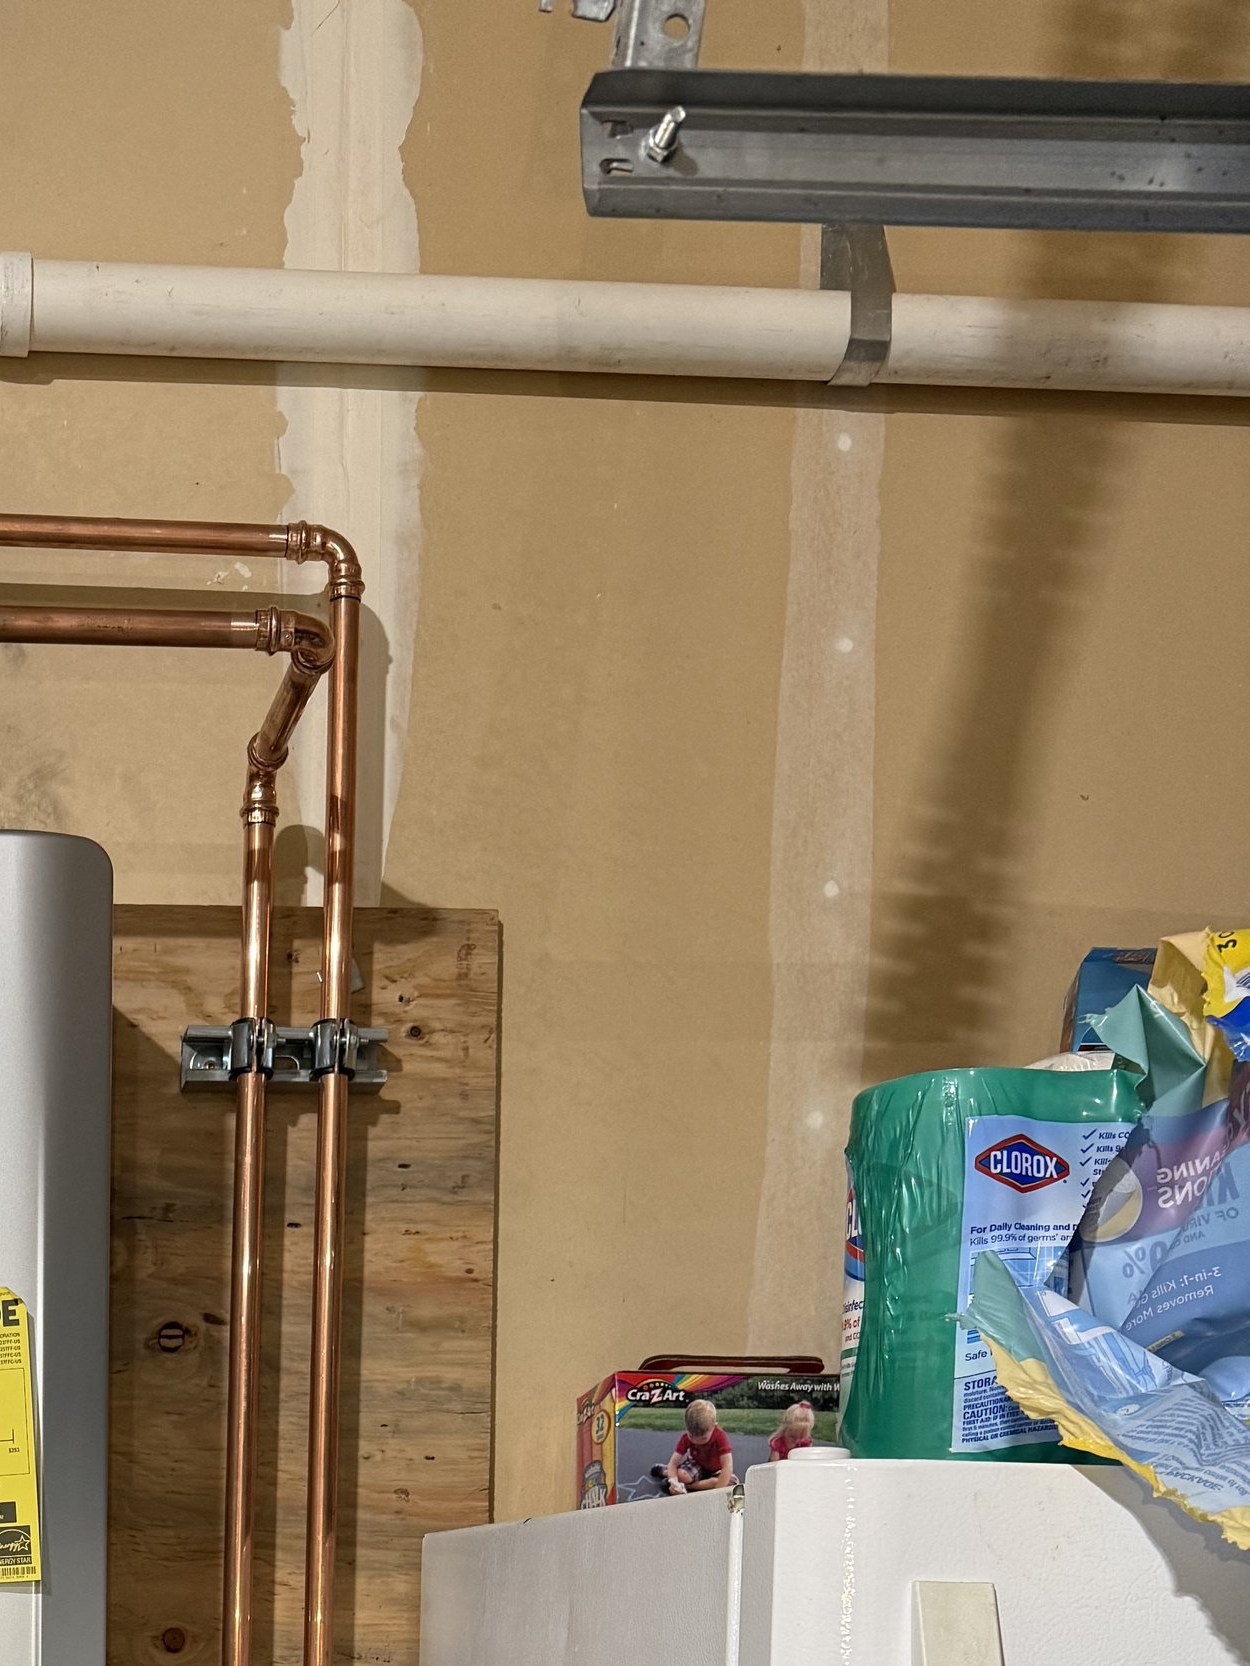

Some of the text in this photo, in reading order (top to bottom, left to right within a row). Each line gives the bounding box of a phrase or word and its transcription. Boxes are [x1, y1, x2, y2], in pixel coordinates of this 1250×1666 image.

[990, 1151, 1058, 1178] CLOROX
[971, 1226, 987, 1234] For
[990, 1223, 1012, 1232] Daily
[1014, 1223, 1050, 1231] Cleaning
[970, 1237, 988, 1246] Kills
[991, 1235, 1017, 1243] 99.9%
[965, 1350, 987, 1361] Safe
[758, 1380, 831, 1392] Washes Away with
[964, 1376, 997, 1390] STORA
[963, 1397, 1012, 1410] PRECAUTIONA
[963, 1405, 1008, 1420] CAUTION:
